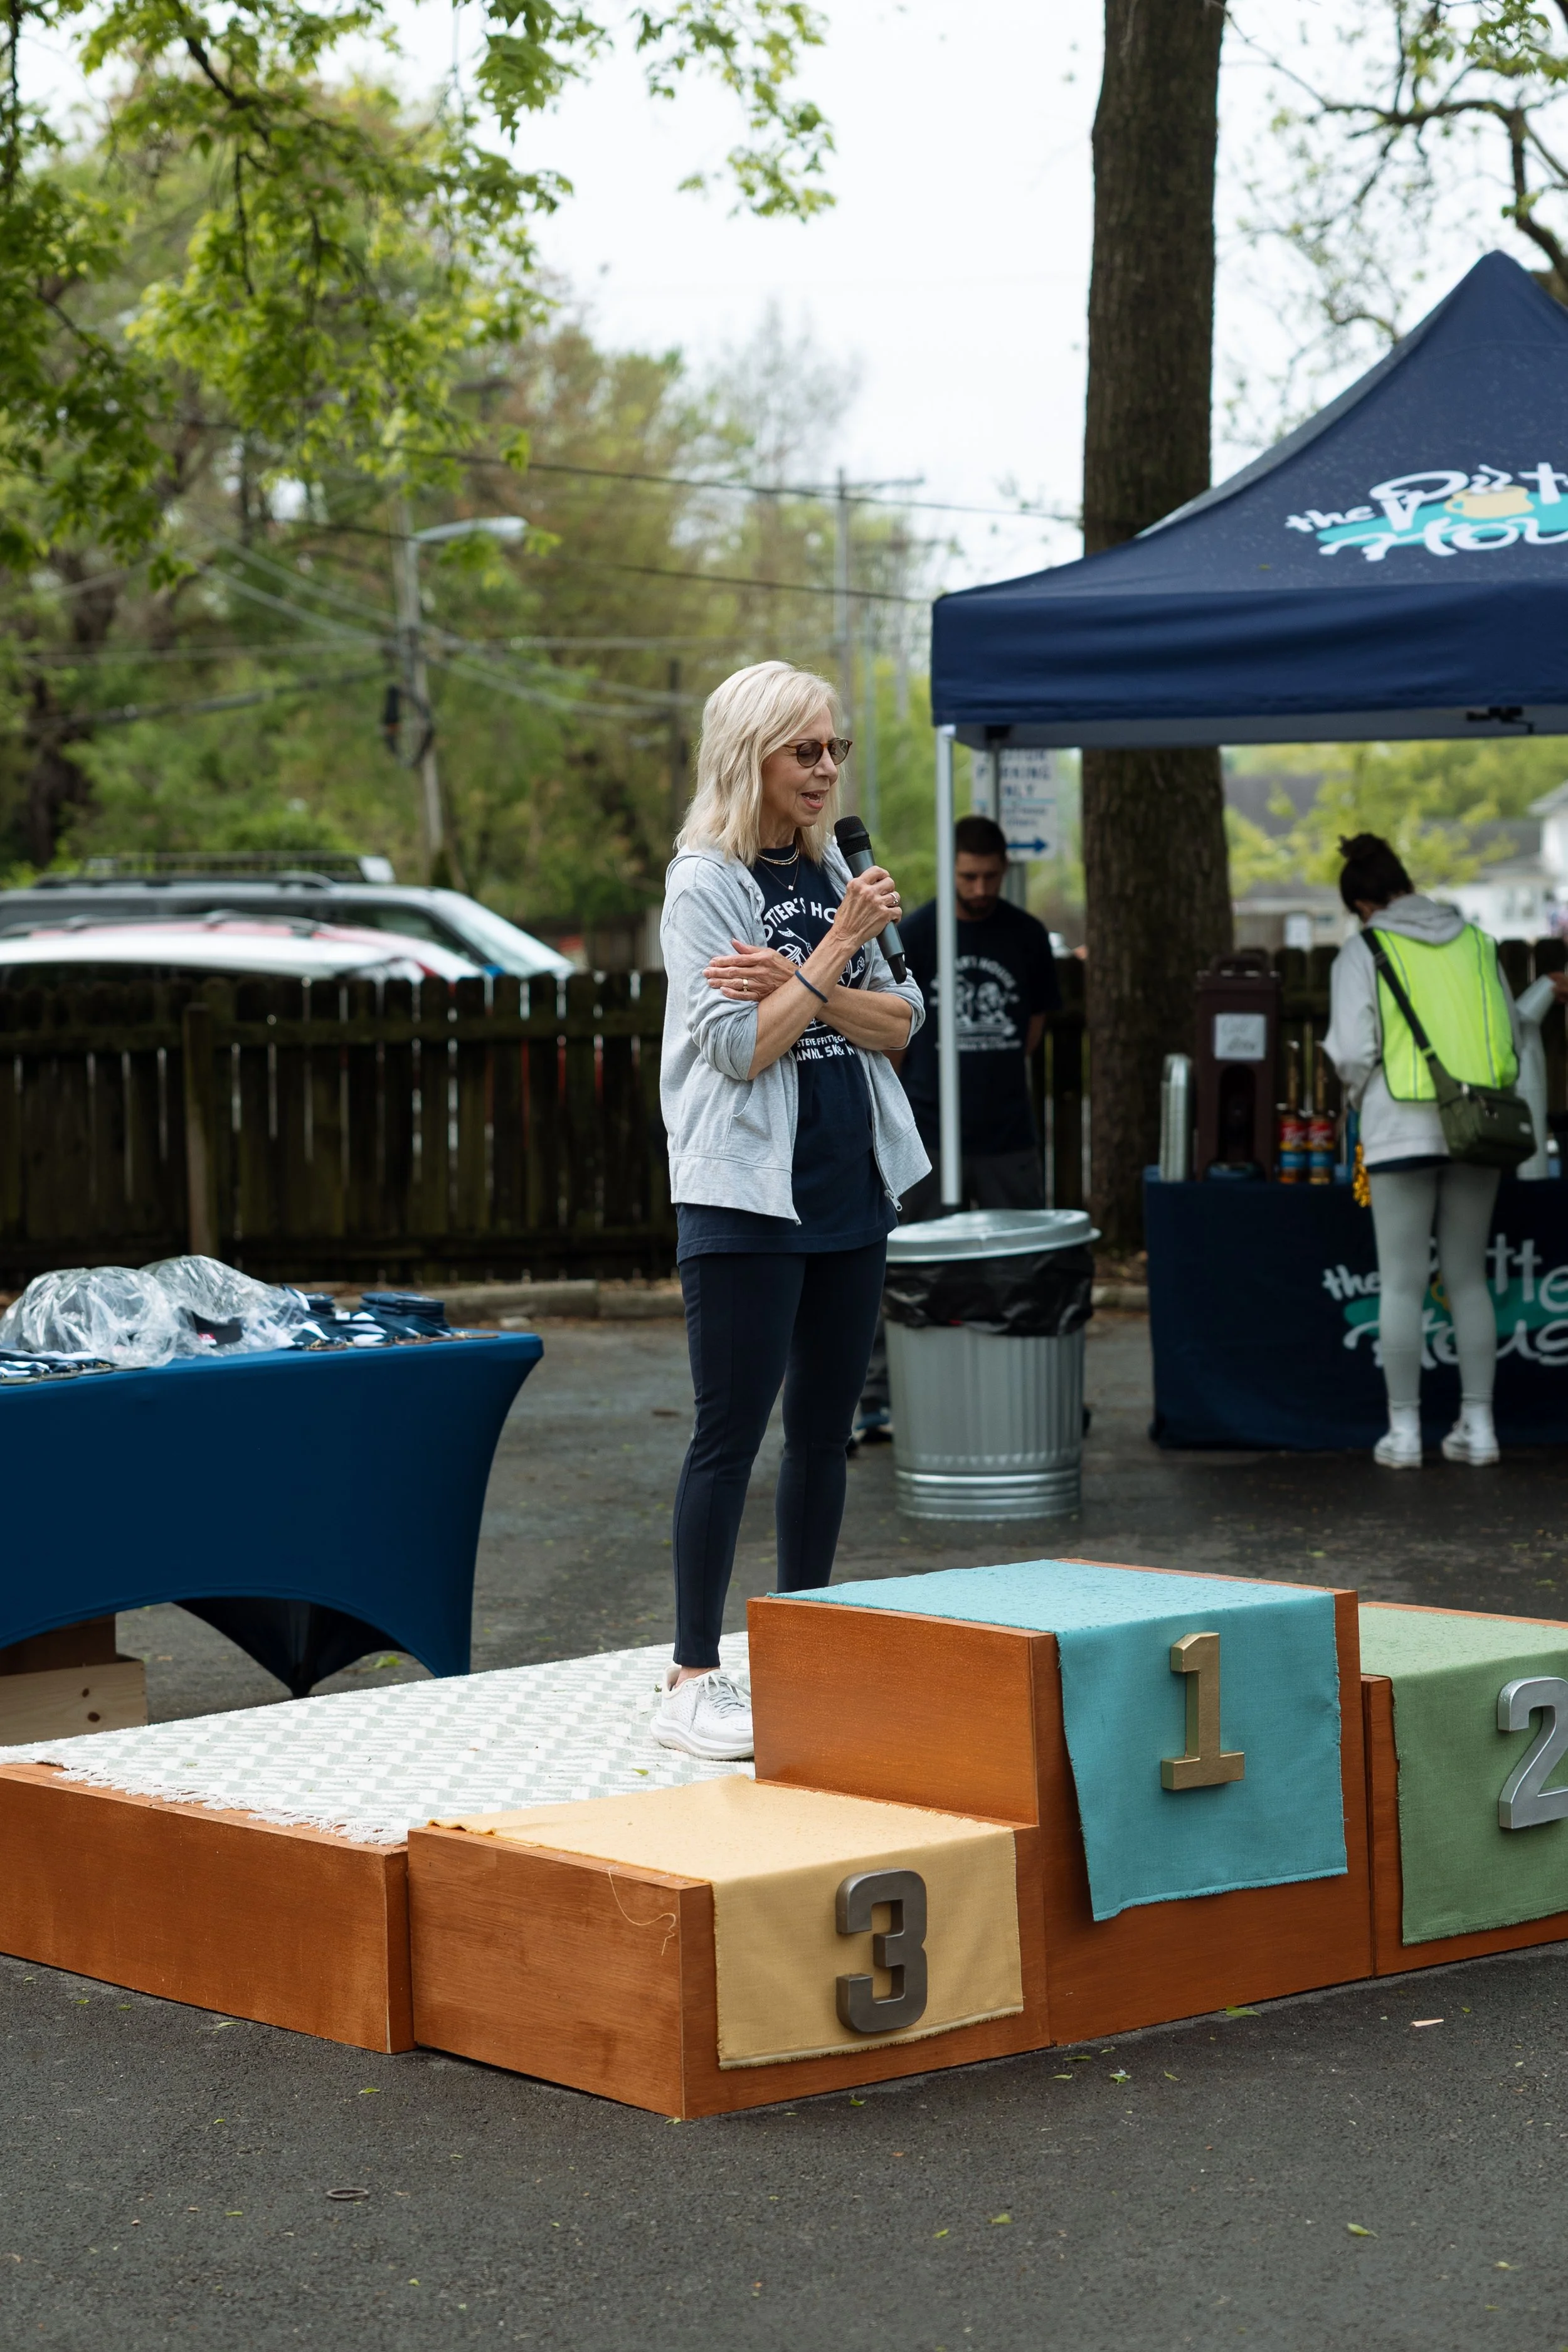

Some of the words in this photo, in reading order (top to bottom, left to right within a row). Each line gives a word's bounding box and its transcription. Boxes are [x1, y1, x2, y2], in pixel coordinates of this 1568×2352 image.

[1284, 504, 1377, 533] the
[976, 765, 1052, 780] PRKING
[763, 897, 806, 942] OTTER'S
[1162, 1631, 1244, 1790] 1
[1498, 1675, 1568, 1829] 2
[835, 1867, 927, 2032] 3
